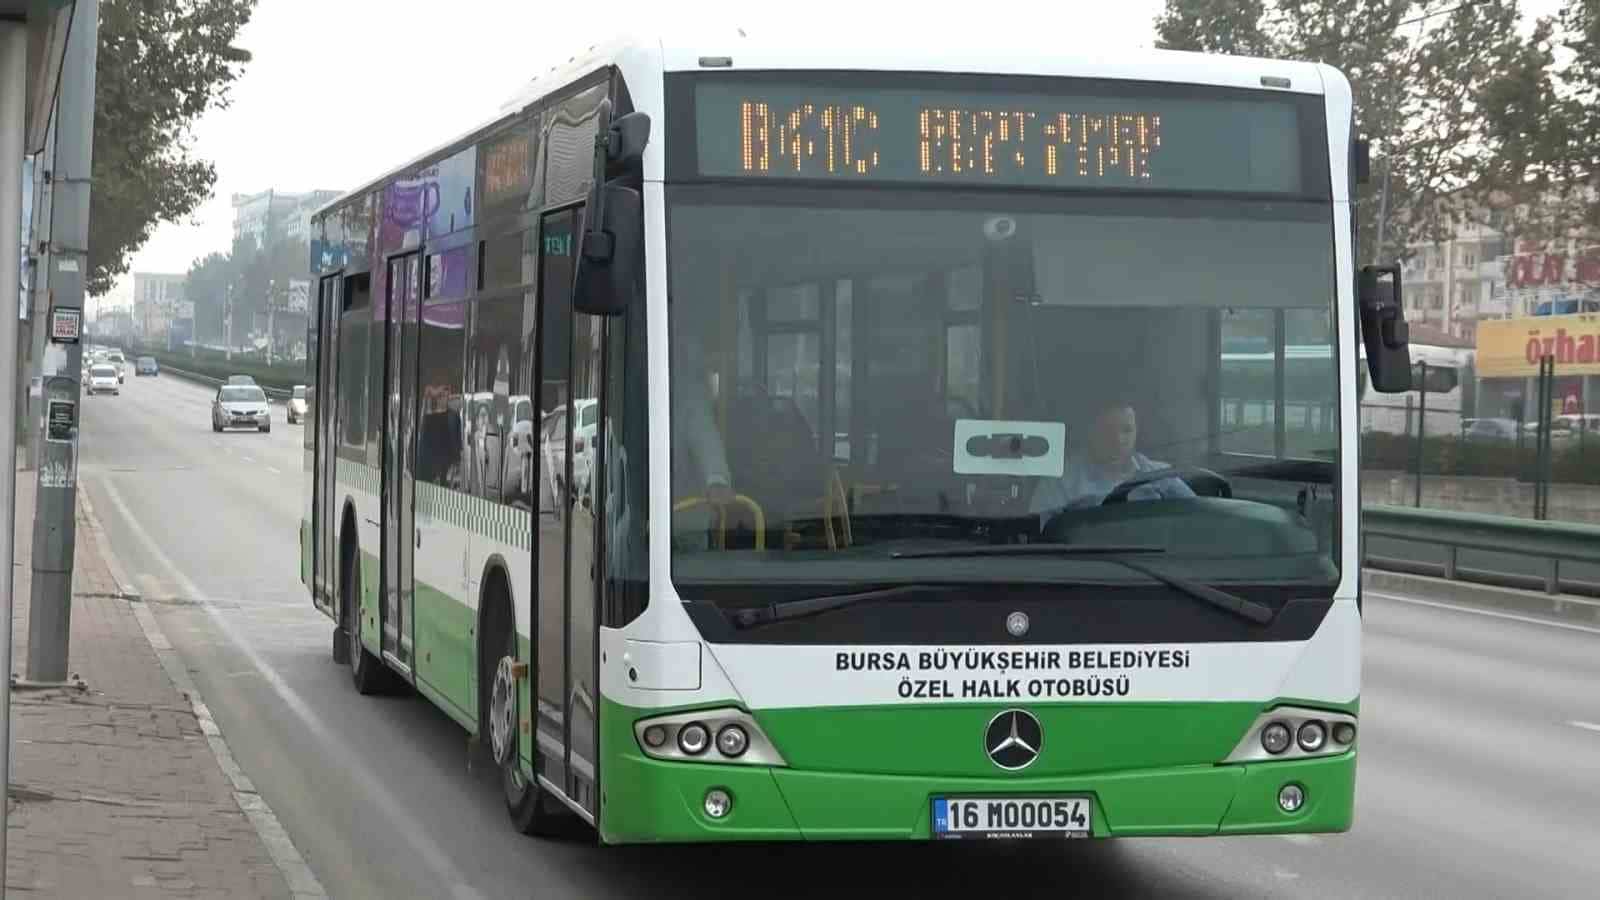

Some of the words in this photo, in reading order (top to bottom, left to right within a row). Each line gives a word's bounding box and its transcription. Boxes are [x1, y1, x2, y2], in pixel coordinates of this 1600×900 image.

[835, 652, 911, 671] BURSA
[897, 678, 954, 698] ÖZEL
[962, 680, 1021, 697] HALK
[1027, 675, 1130, 697] OTOBÜSÜ
[950, 801, 979, 829] 16
